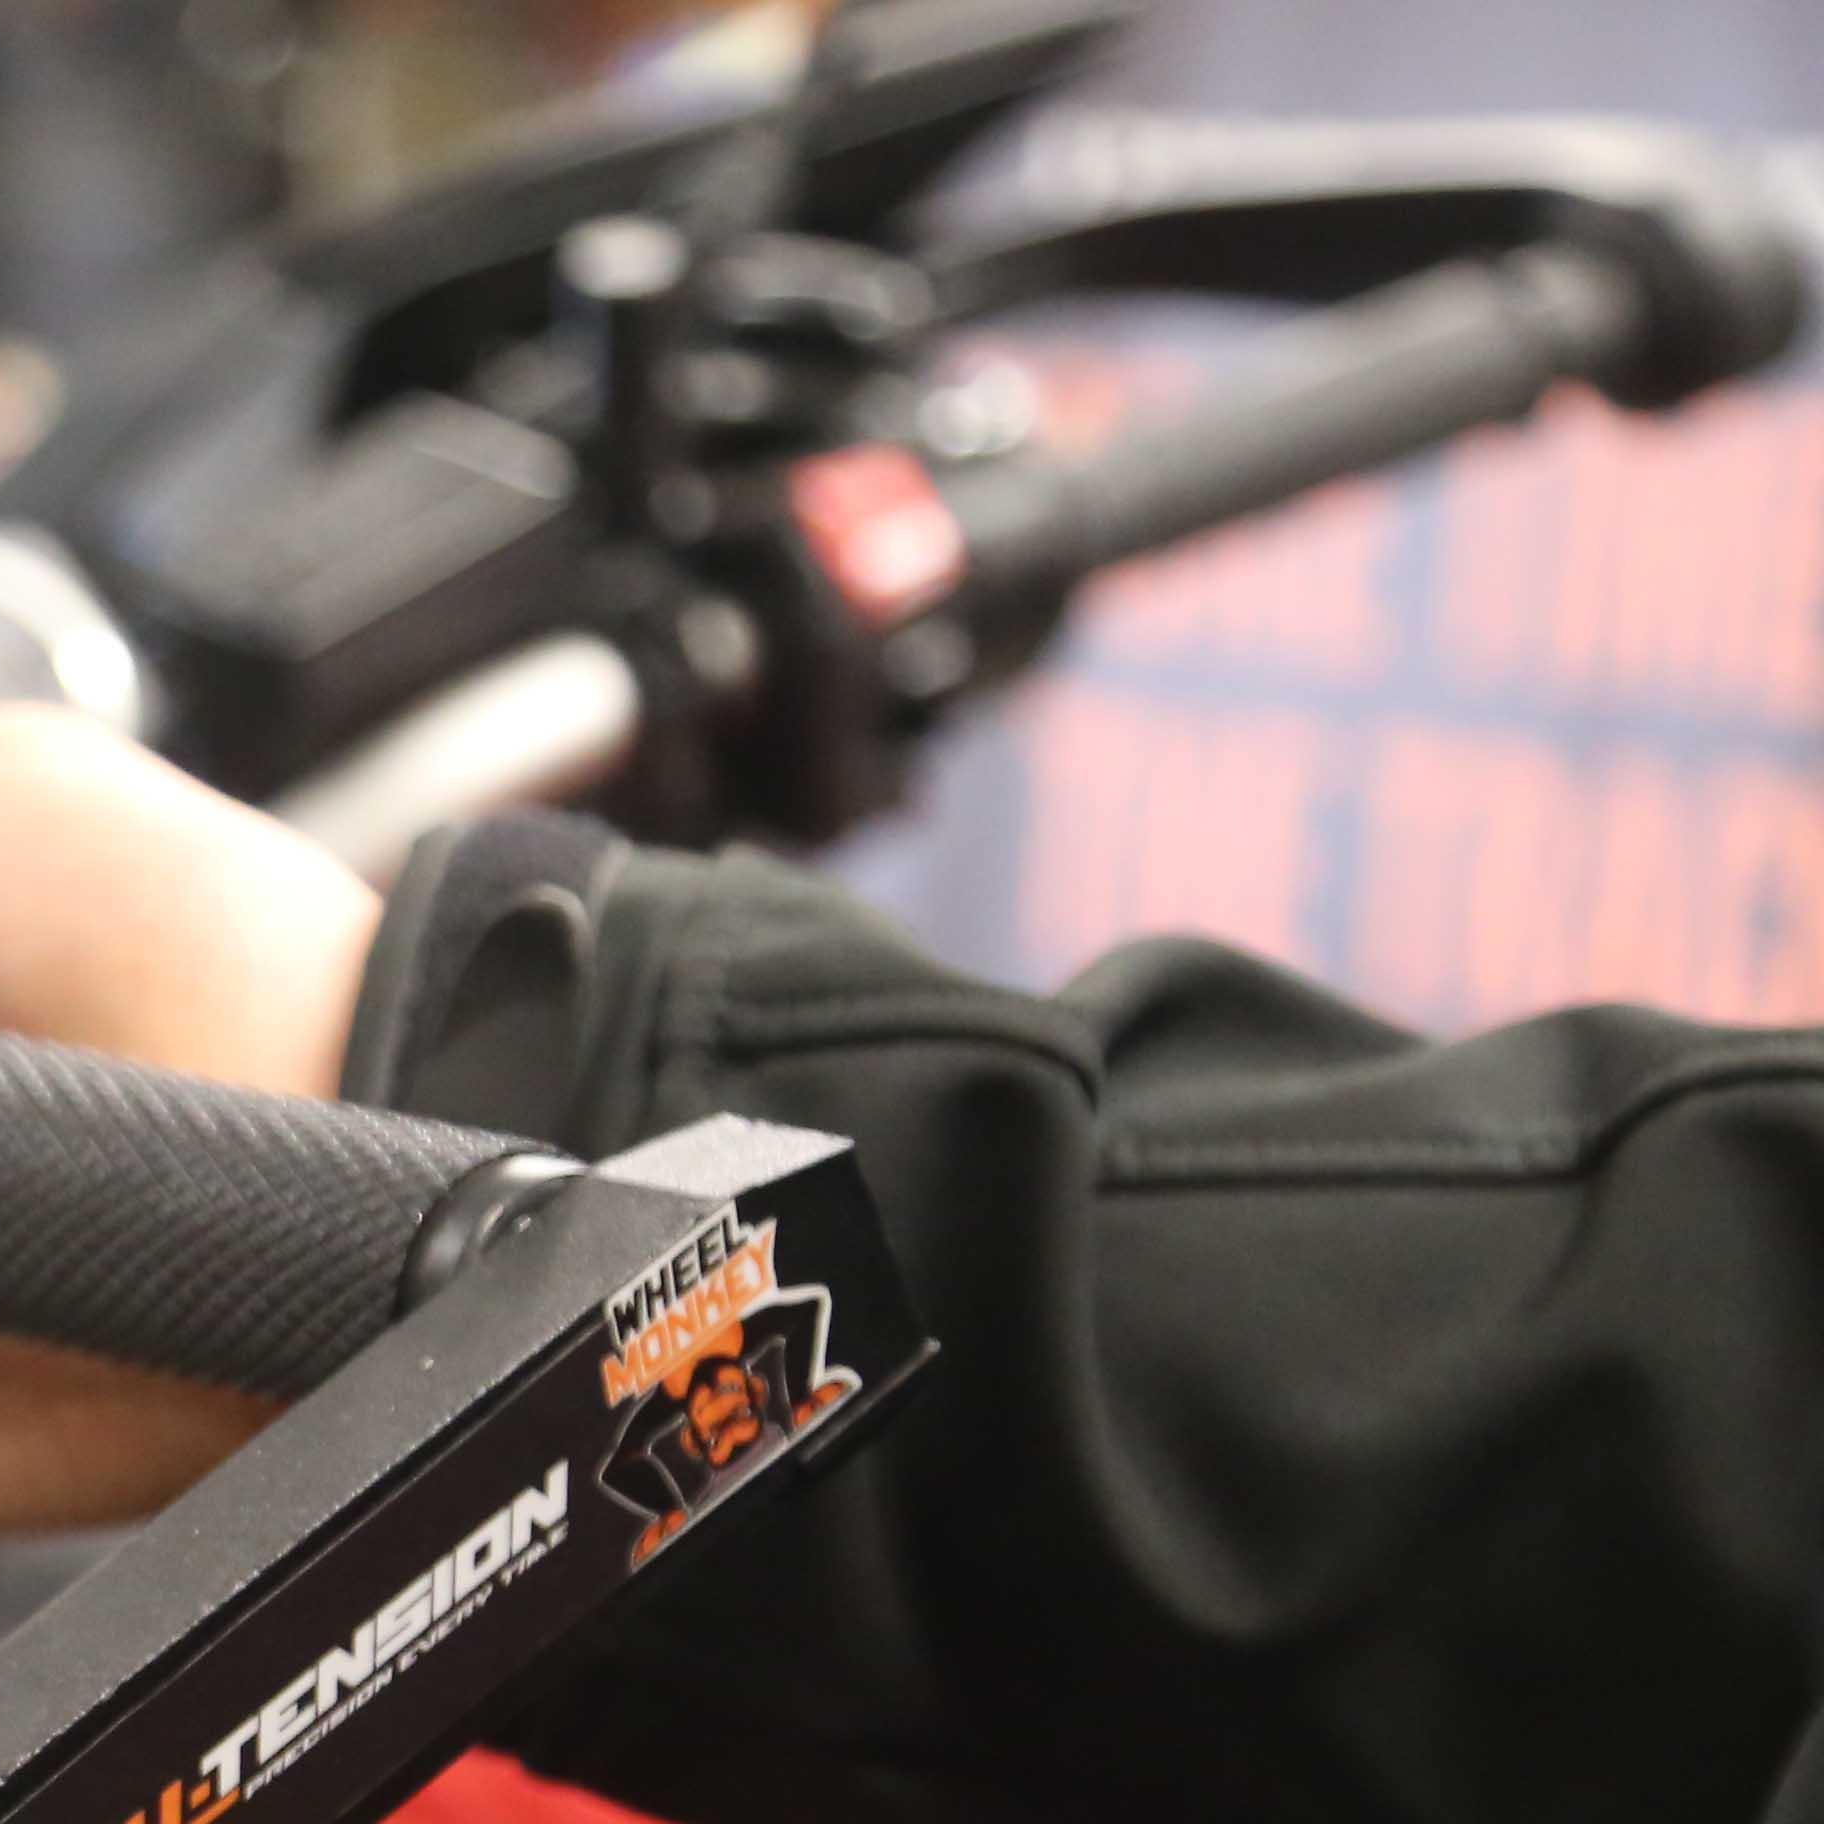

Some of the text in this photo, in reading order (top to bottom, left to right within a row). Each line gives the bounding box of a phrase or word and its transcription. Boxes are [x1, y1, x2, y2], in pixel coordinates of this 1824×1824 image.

[603, 1229, 773, 1406] MONKEY
[612, 1215, 749, 1345] WHEEL
[244, 1521, 569, 1801] PRECISION EVERY TIME
